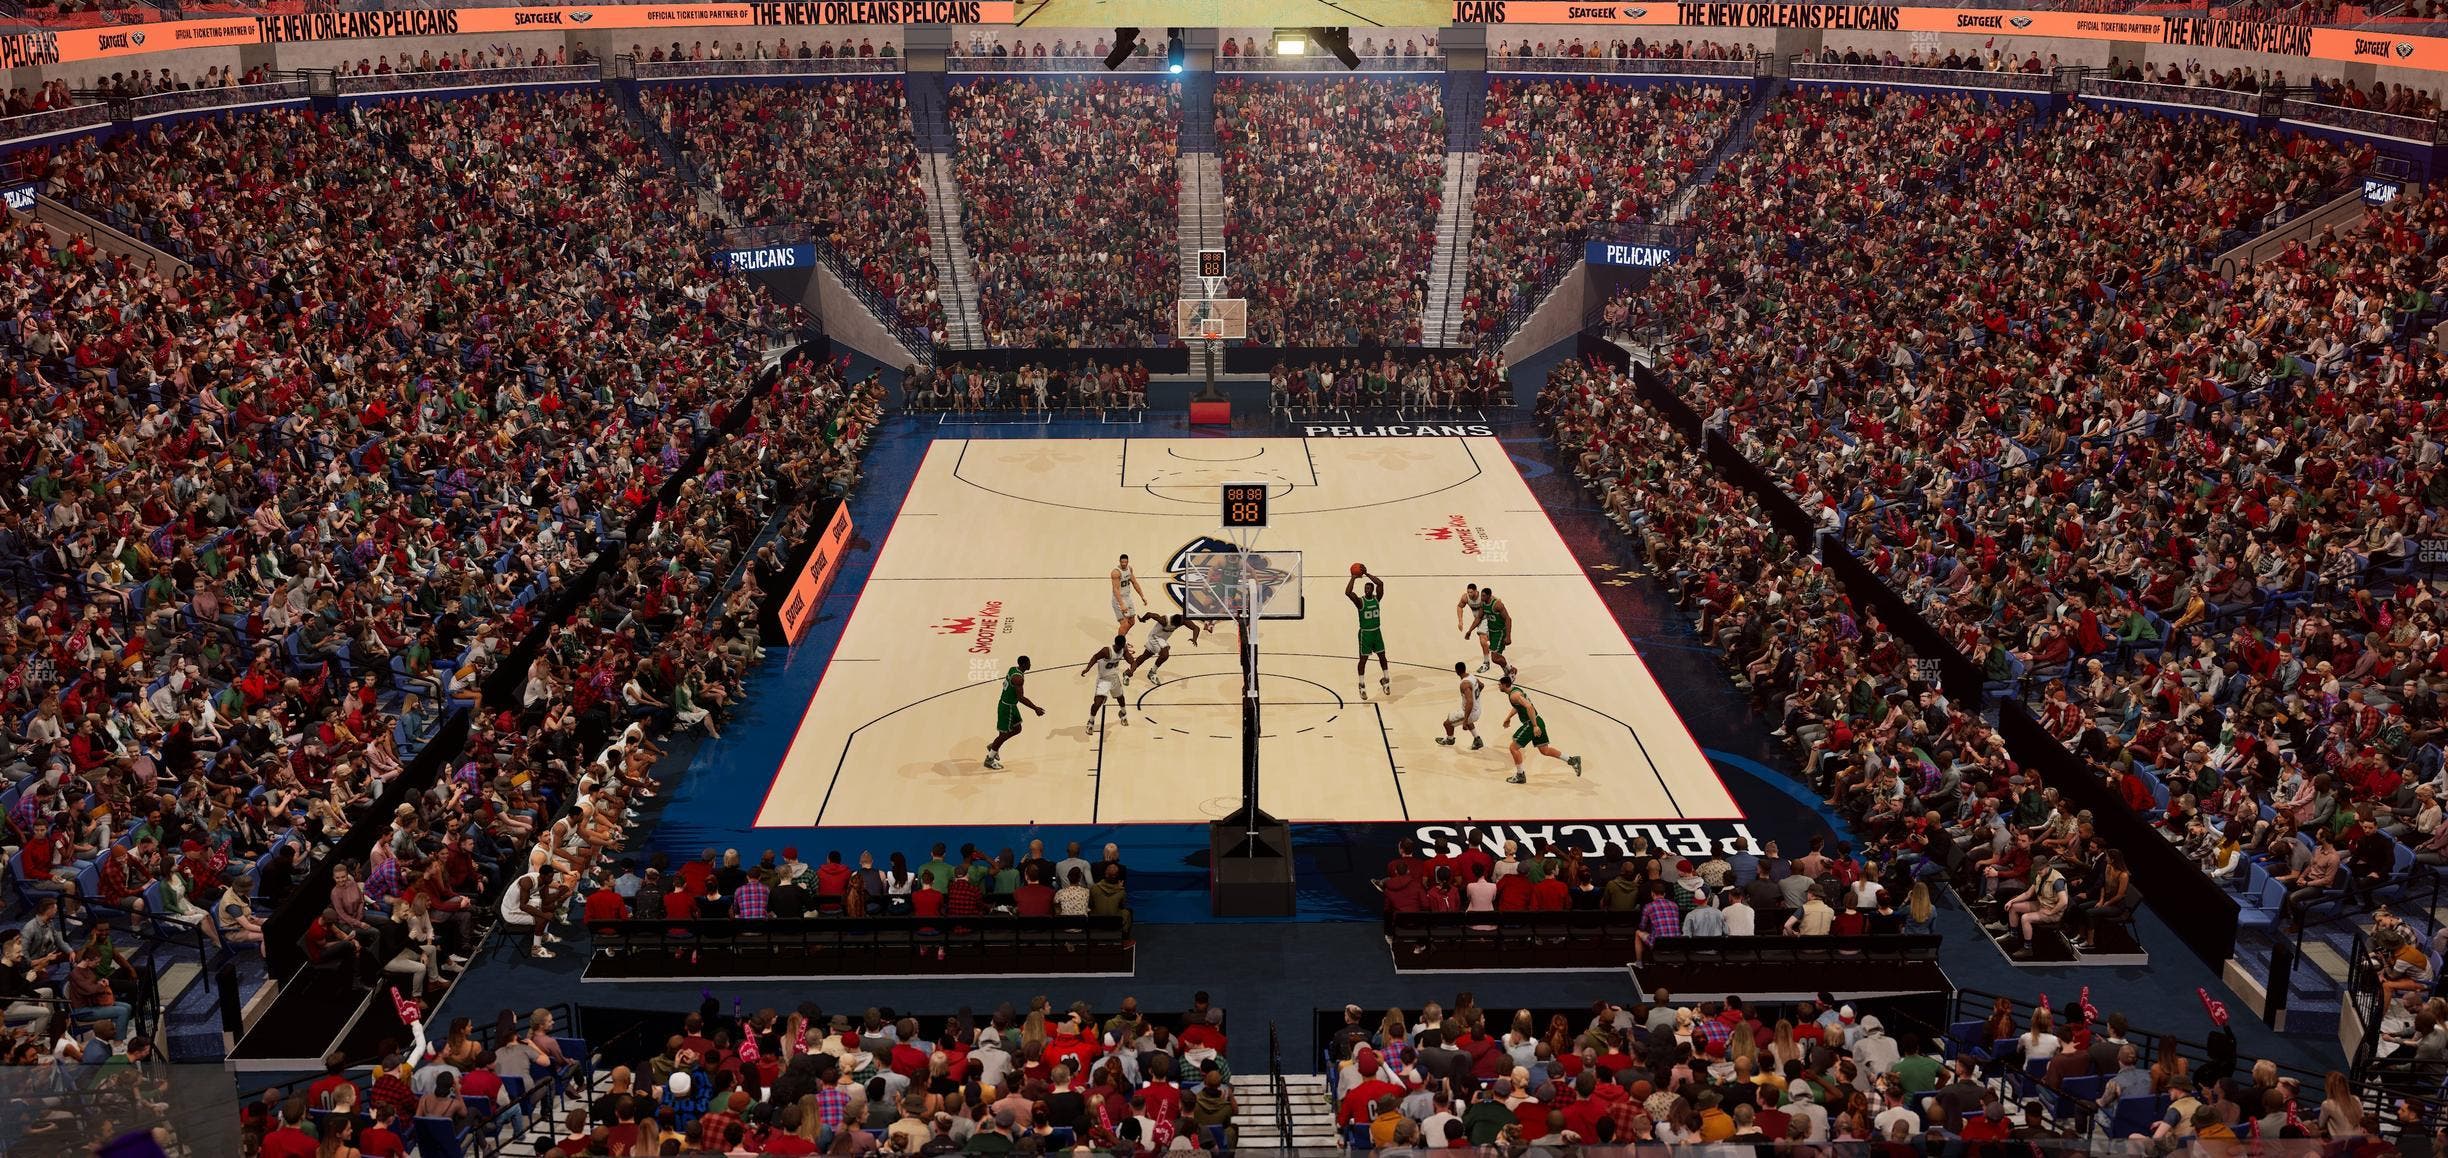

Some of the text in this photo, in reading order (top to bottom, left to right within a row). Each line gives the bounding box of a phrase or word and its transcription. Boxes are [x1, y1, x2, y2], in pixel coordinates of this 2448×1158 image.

[515, 11, 562, 26] SEATGEEK
[648, 9, 748, 20] OFFICIAL TICKETING PARTNER OF
[751, 1, 981, 26] THE NEW ORLEANS PELICANS
[1568, 6, 1616, 20] SEATGEEK
[1678, 3, 1899, 31] THE NEW ORLEANS PELICANS
[1957, 14, 2002, 29] SEATGEEK
[193, 26, 222, 39] TICKETING
[223, 25, 247, 37] PARTNER
[248, 25, 255, 35] OF
[256, 9, 458, 43] THE NEW ORLEANS PELICANS
[2077, 20, 2160, 35] OFFICIAL TICKETING PARTNER OF
[99, 32, 128, 50] SEATGEEK
[2163, 16, 2313, 57] THE NEW ORLEANS PELICANS
[2, 31, 59, 69] PELICANS
[2354, 38, 2392, 59] SEATGEEK
[731, 247, 795, 270] PELICANS
[1607, 244, 1671, 267] PELICANS
[1304, 425, 1493, 437] PELICANS
[1232, 502, 1258, 522] 88
[1416, 823, 1765, 859] PELICANS
